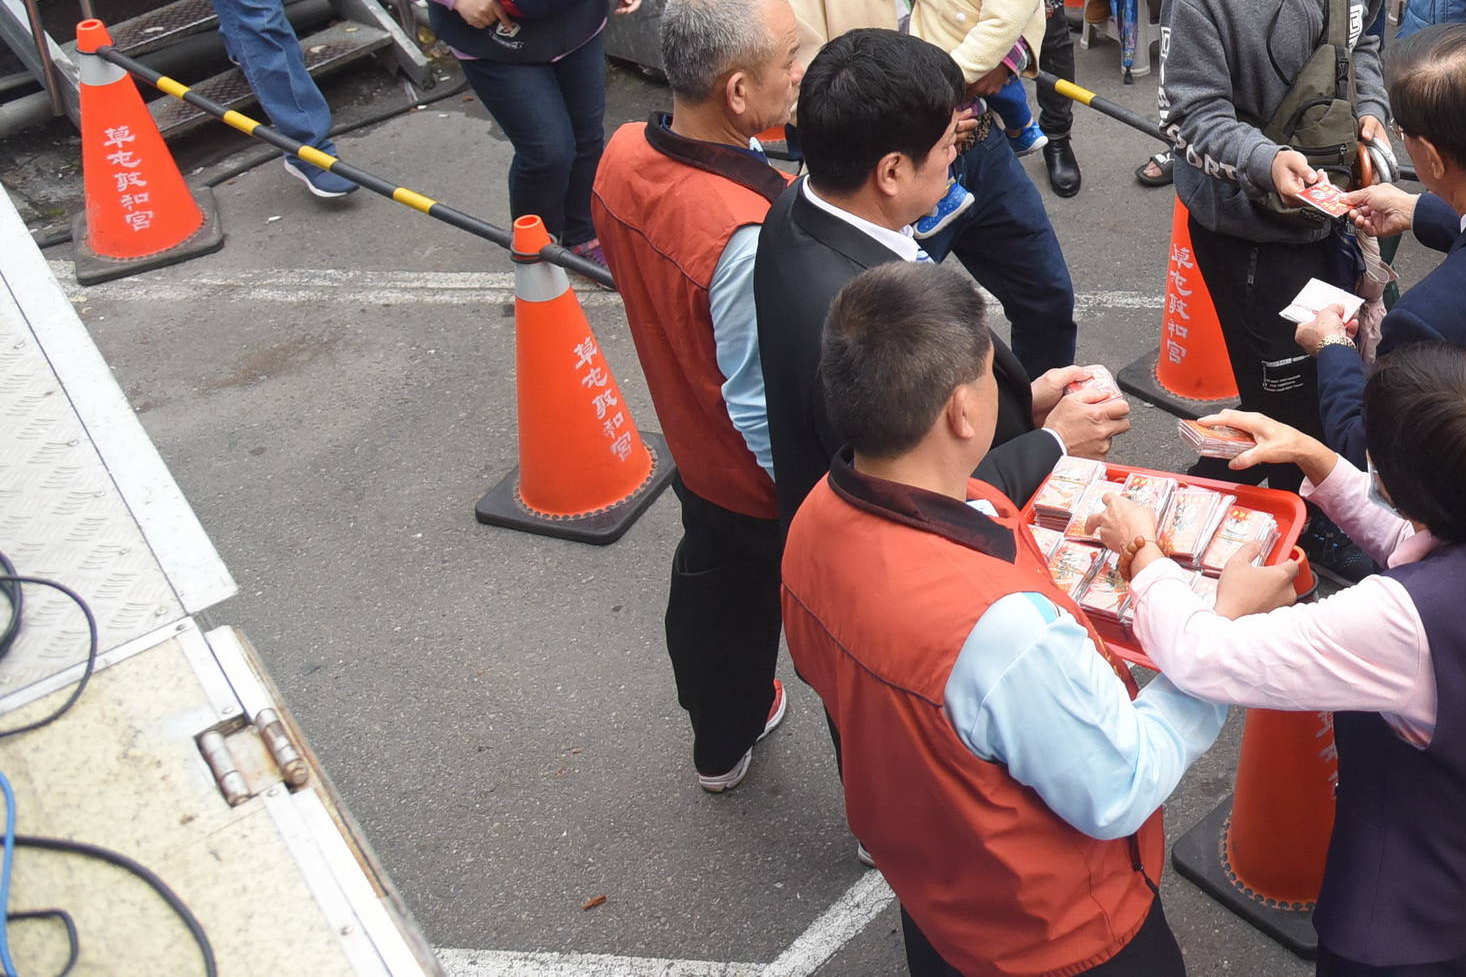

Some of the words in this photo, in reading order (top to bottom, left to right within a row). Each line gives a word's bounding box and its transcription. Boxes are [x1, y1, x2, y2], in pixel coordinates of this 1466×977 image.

[103, 125, 154, 232] 草屯敦和宮
[1167, 243, 1195, 365] 草屯敦和宮
[573, 336, 632, 462] 草屯敦和宮
